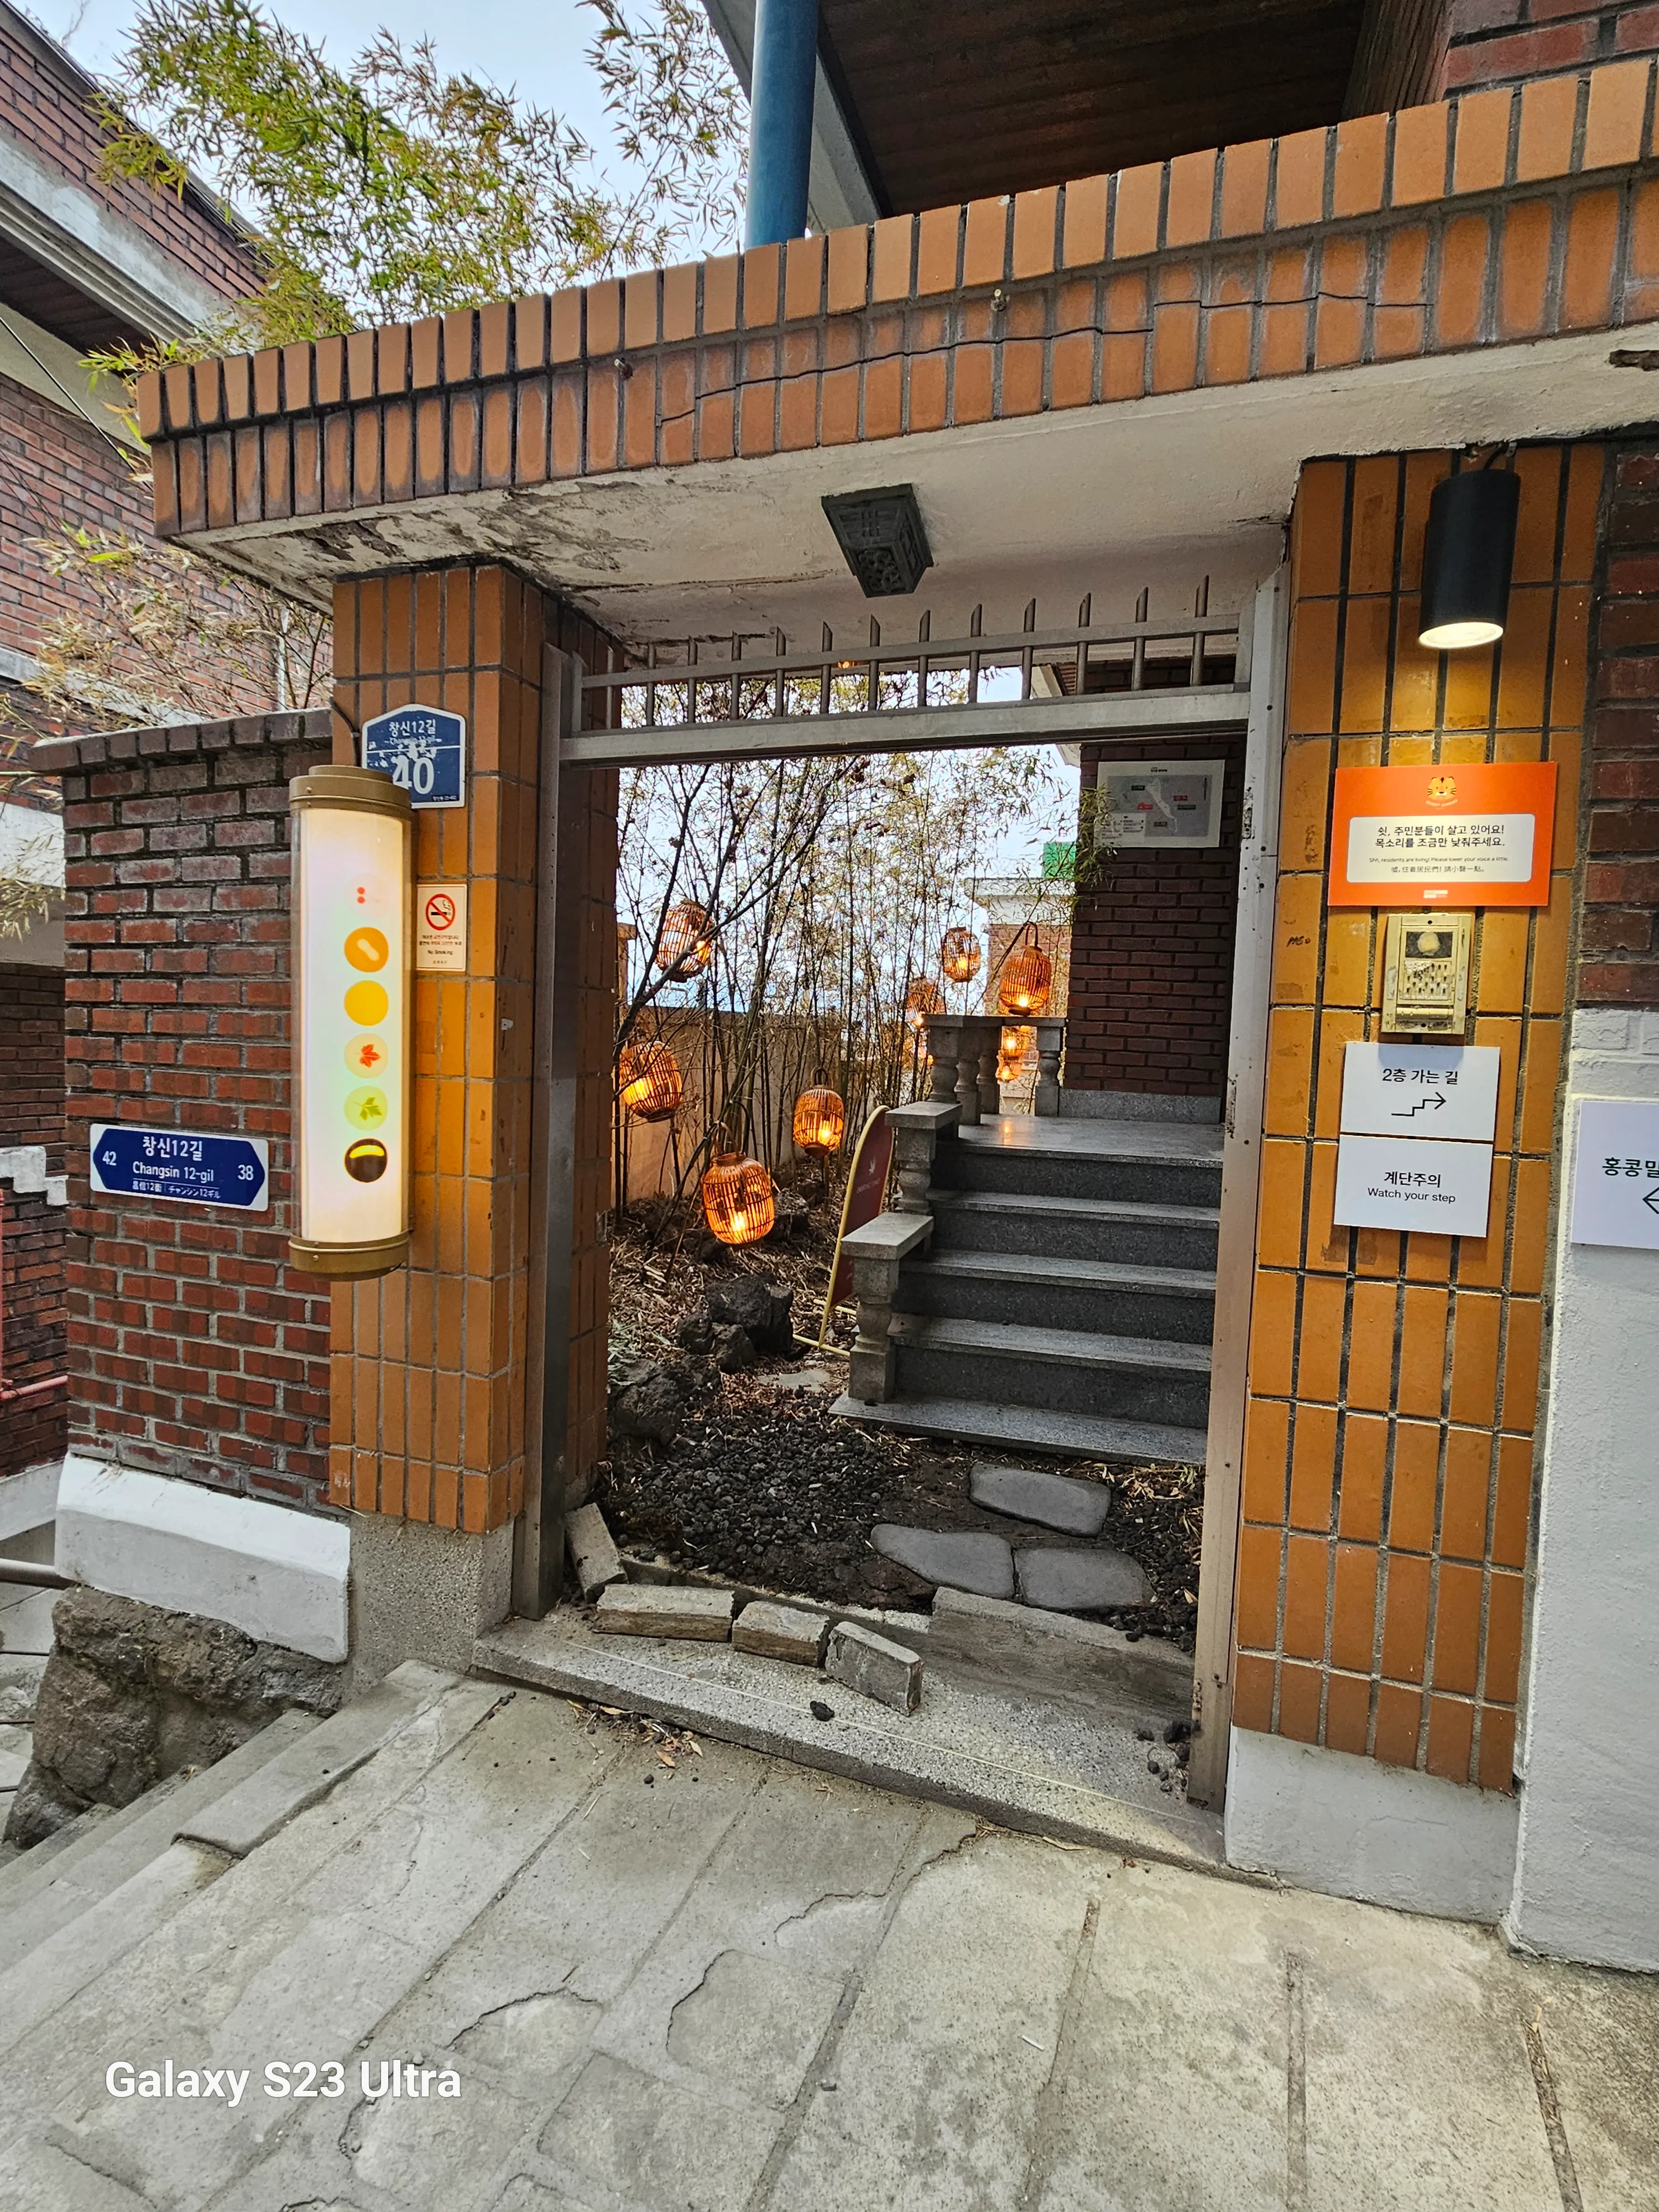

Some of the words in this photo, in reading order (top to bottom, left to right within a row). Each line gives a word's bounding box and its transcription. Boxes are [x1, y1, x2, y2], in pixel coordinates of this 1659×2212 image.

[389, 719, 436, 737] 창신12길
[390, 755, 434, 795] 40
[1378, 826, 1390, 837] 쉿,
[1394, 826, 1444, 836] 주민분들이
[1447, 826, 1467, 836] 살고
[1471, 825, 1505, 836] 있어요!
[1375, 838, 1415, 848] 목소리를
[1417, 837, 1447, 848] 조금만
[1382, 1068, 1407, 1083] 2층
[1411, 1070, 1440, 1084] 가는
[1444, 1071, 1458, 1085] 길
[142, 1135, 203, 1162] 창신12길
[102, 1151, 117, 1166] 42
[132, 1161, 180, 1180] Changsin
[184, 1166, 215, 1183] 12-gil
[237, 1164, 254, 1181] 38
[1384, 1171, 1442, 1188] 계단주의
[1368, 1187, 1401, 1198] Watch
[1405, 1191, 1429, 1201] your
[1432, 1192, 1456, 1204] step
